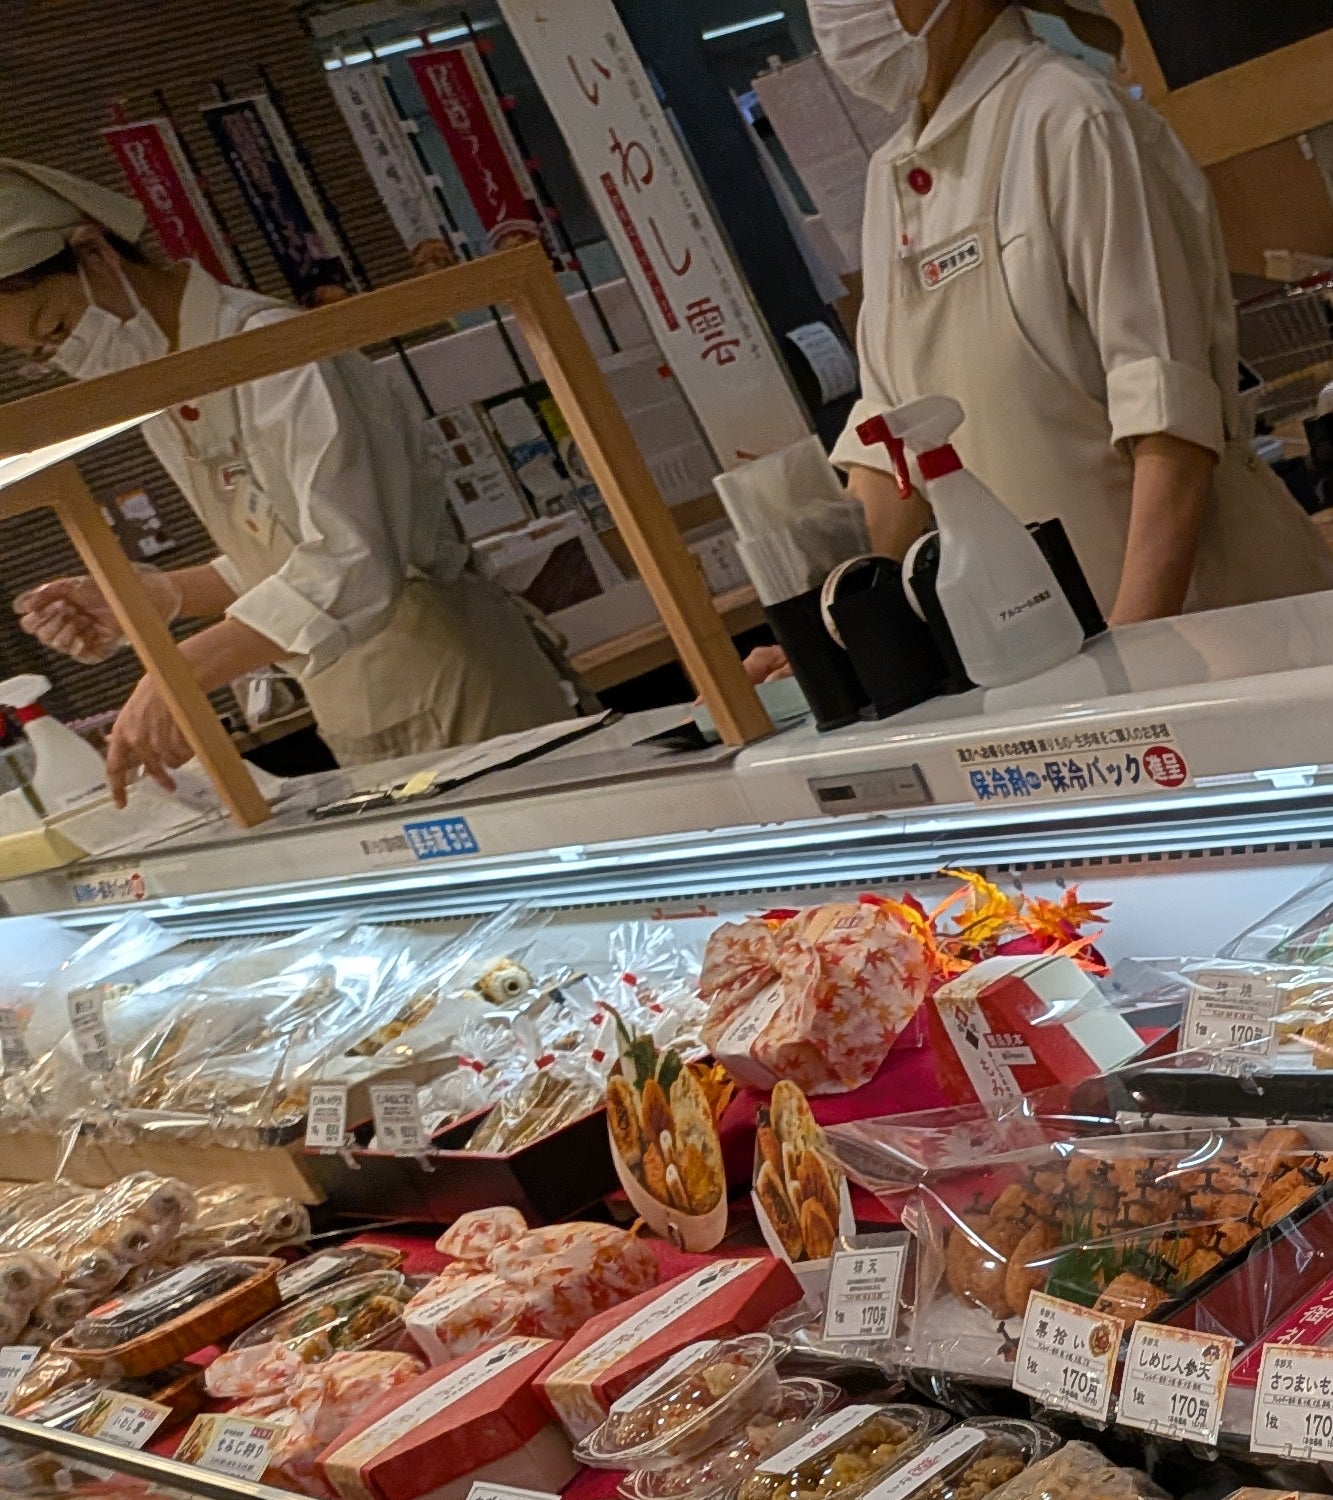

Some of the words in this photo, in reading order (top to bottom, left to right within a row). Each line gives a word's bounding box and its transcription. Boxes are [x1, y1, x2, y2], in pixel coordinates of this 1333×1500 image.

[1138, 1349, 1212, 1381] しめじ人参天
